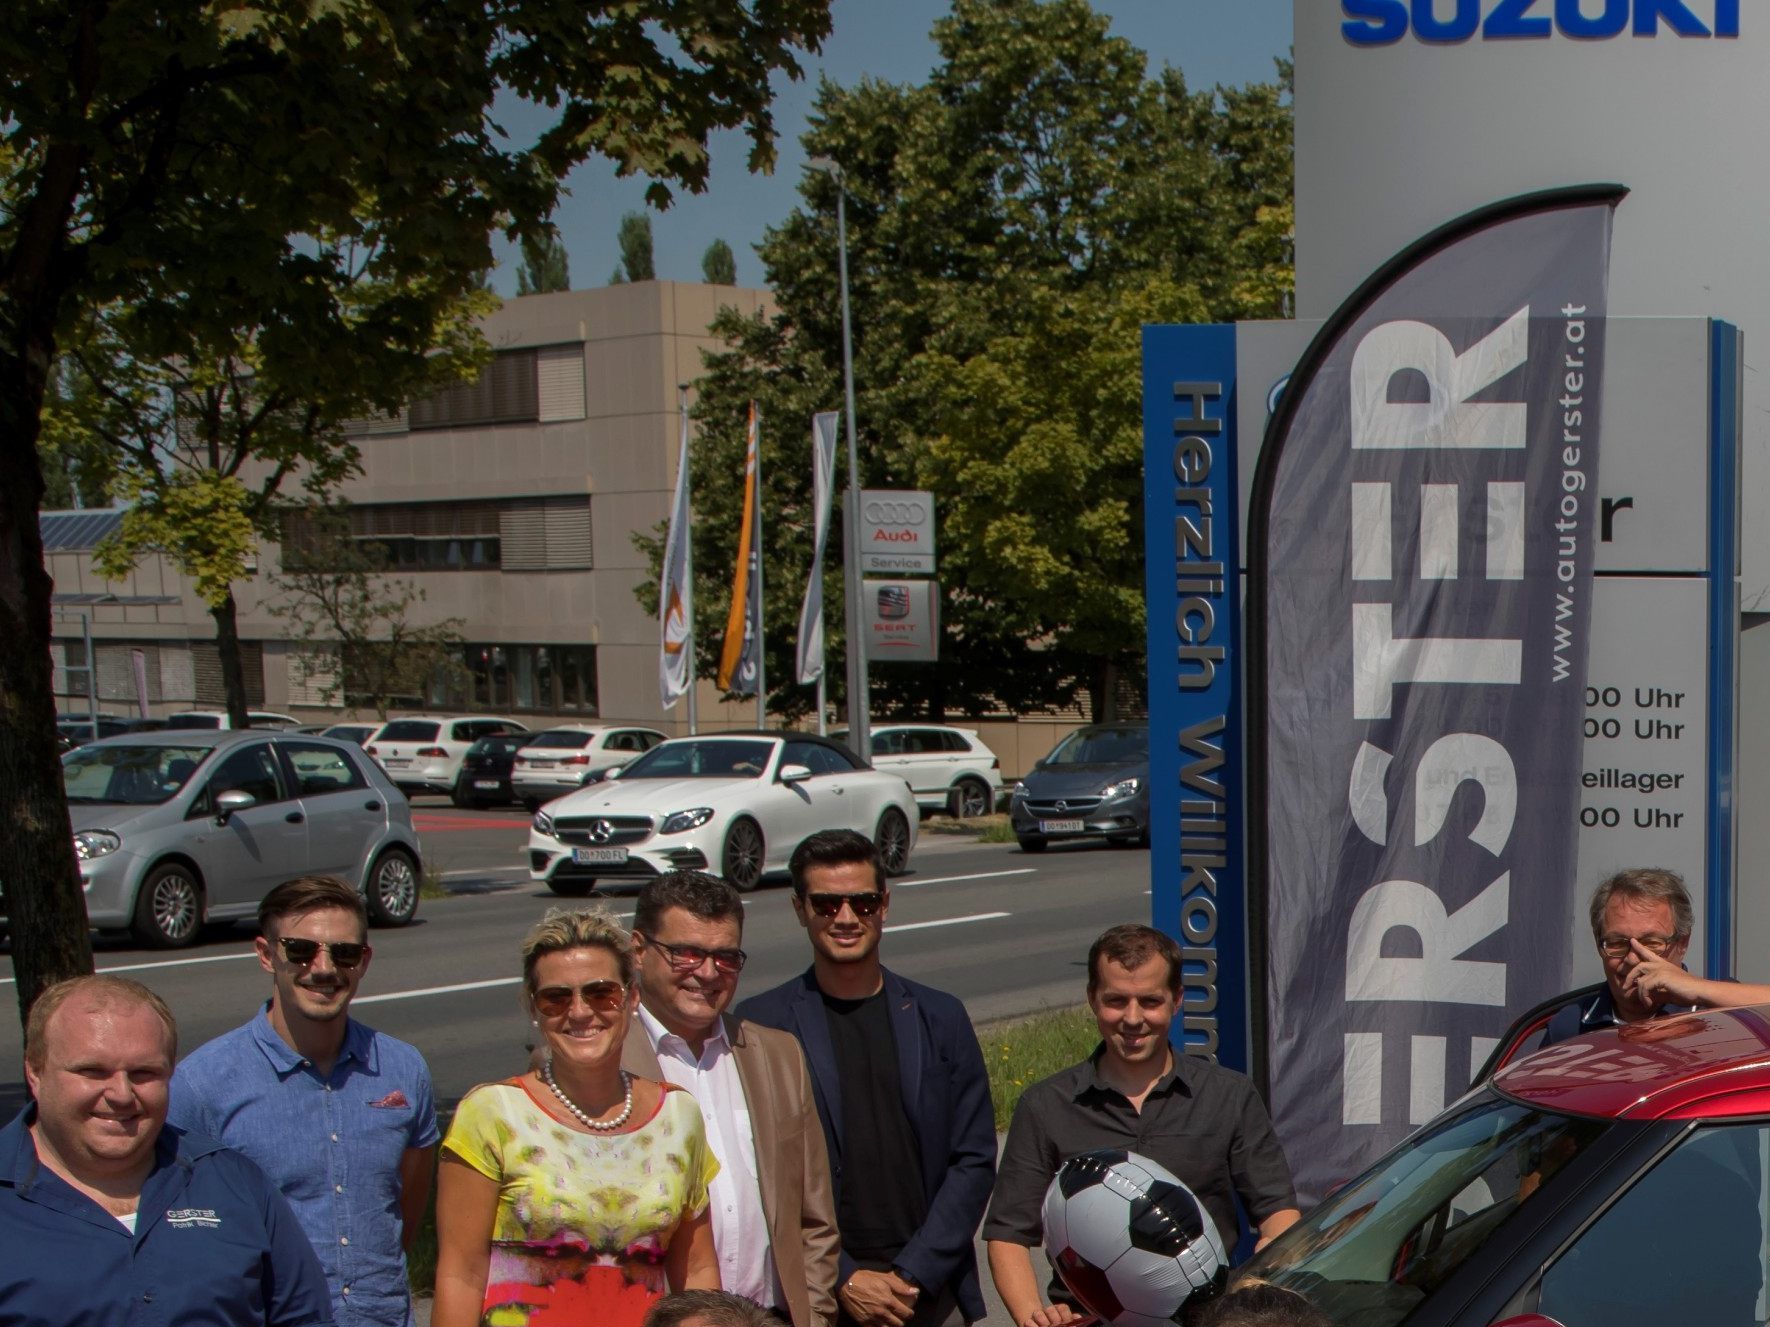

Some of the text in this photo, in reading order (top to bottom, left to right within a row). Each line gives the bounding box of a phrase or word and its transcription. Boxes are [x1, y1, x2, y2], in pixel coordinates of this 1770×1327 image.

[1341, 0, 1739, 46] SUZUKI
[1553, 302, 1586, 682] www.autogerster.at
[873, 529, 918, 542] Audi
[871, 557, 922, 568] Service
[873, 624, 917, 632] SEAT
[1635, 688, 1685, 708] Uhr
[1173, 381, 1228, 1066] Herzlich Willkomm
[1343, 304, 1530, 1125] ERSTER
[1634, 718, 1685, 739] Uhr
[1581, 768, 1685, 793] eillager
[1633, 808, 1684, 828] Uhr
[166, 1208, 217, 1218] GERSTER
